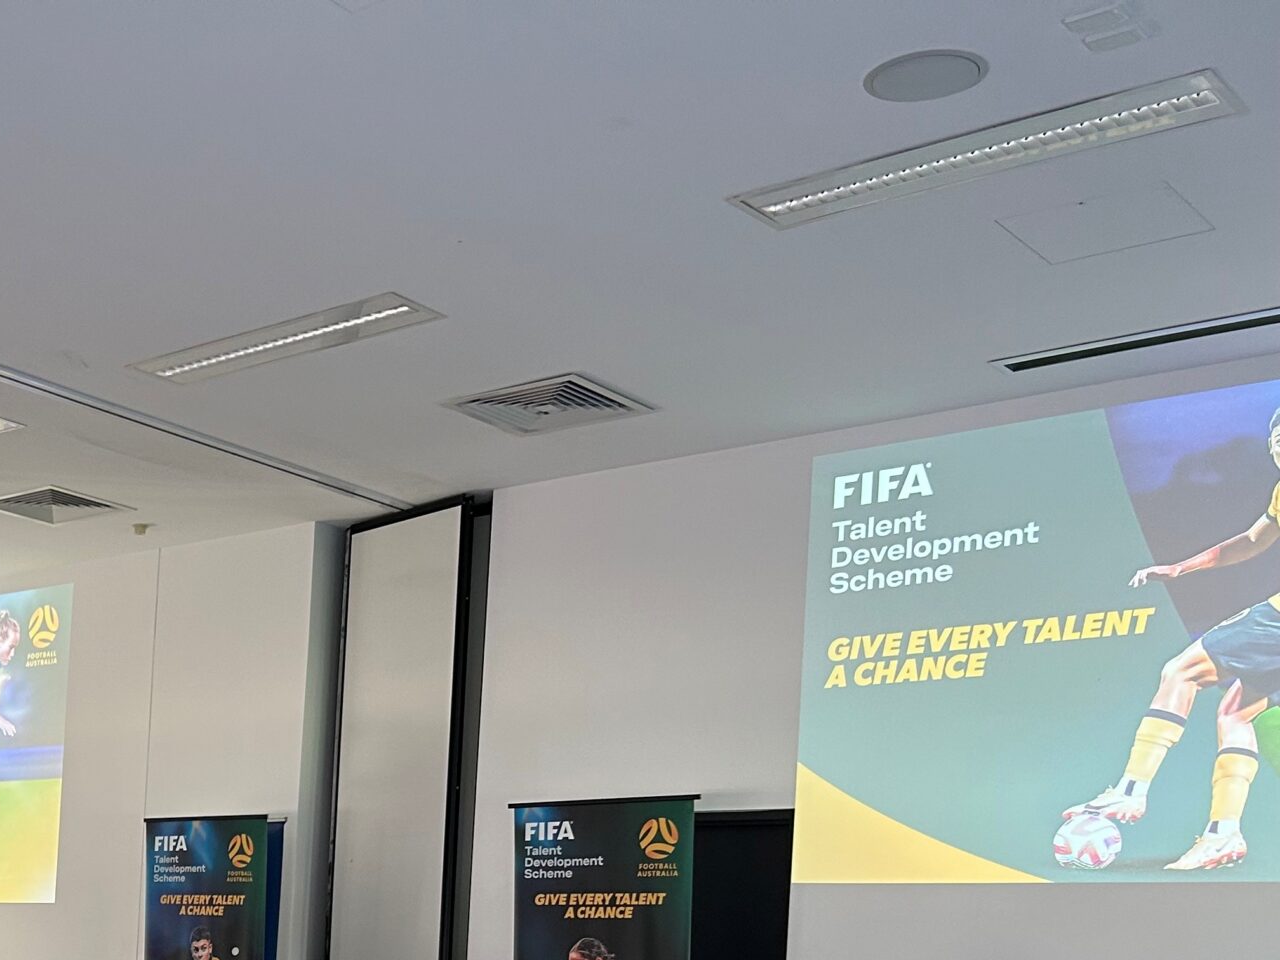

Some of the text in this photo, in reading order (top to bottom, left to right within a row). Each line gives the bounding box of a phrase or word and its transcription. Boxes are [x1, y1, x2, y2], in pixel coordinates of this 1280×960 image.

[833, 462, 933, 509] FIFA
[832, 510, 927, 542] Talent
[831, 521, 1040, 568] Development
[829, 564, 953, 594] Scheme
[827, 608, 1156, 662] GIVE EVERY TALENT
[824, 652, 988, 689] A CHANCE
[524, 820, 575, 841] FIFA
[154, 835, 187, 851] FIFA
[524, 845, 562, 856] Talent
[154, 855, 179, 863] Talent
[524, 856, 603, 868] Development
[154, 865, 206, 874] Development
[524, 868, 573, 879] Scheme
[153, 874, 185, 882] Scheme
[160, 894, 245, 905] GIVE EVERY TALENT
[534, 893, 666, 906] GIVE EVERY TALENT
[179, 906, 224, 916] A CHANCE
[564, 907, 634, 919] A CHANCE
